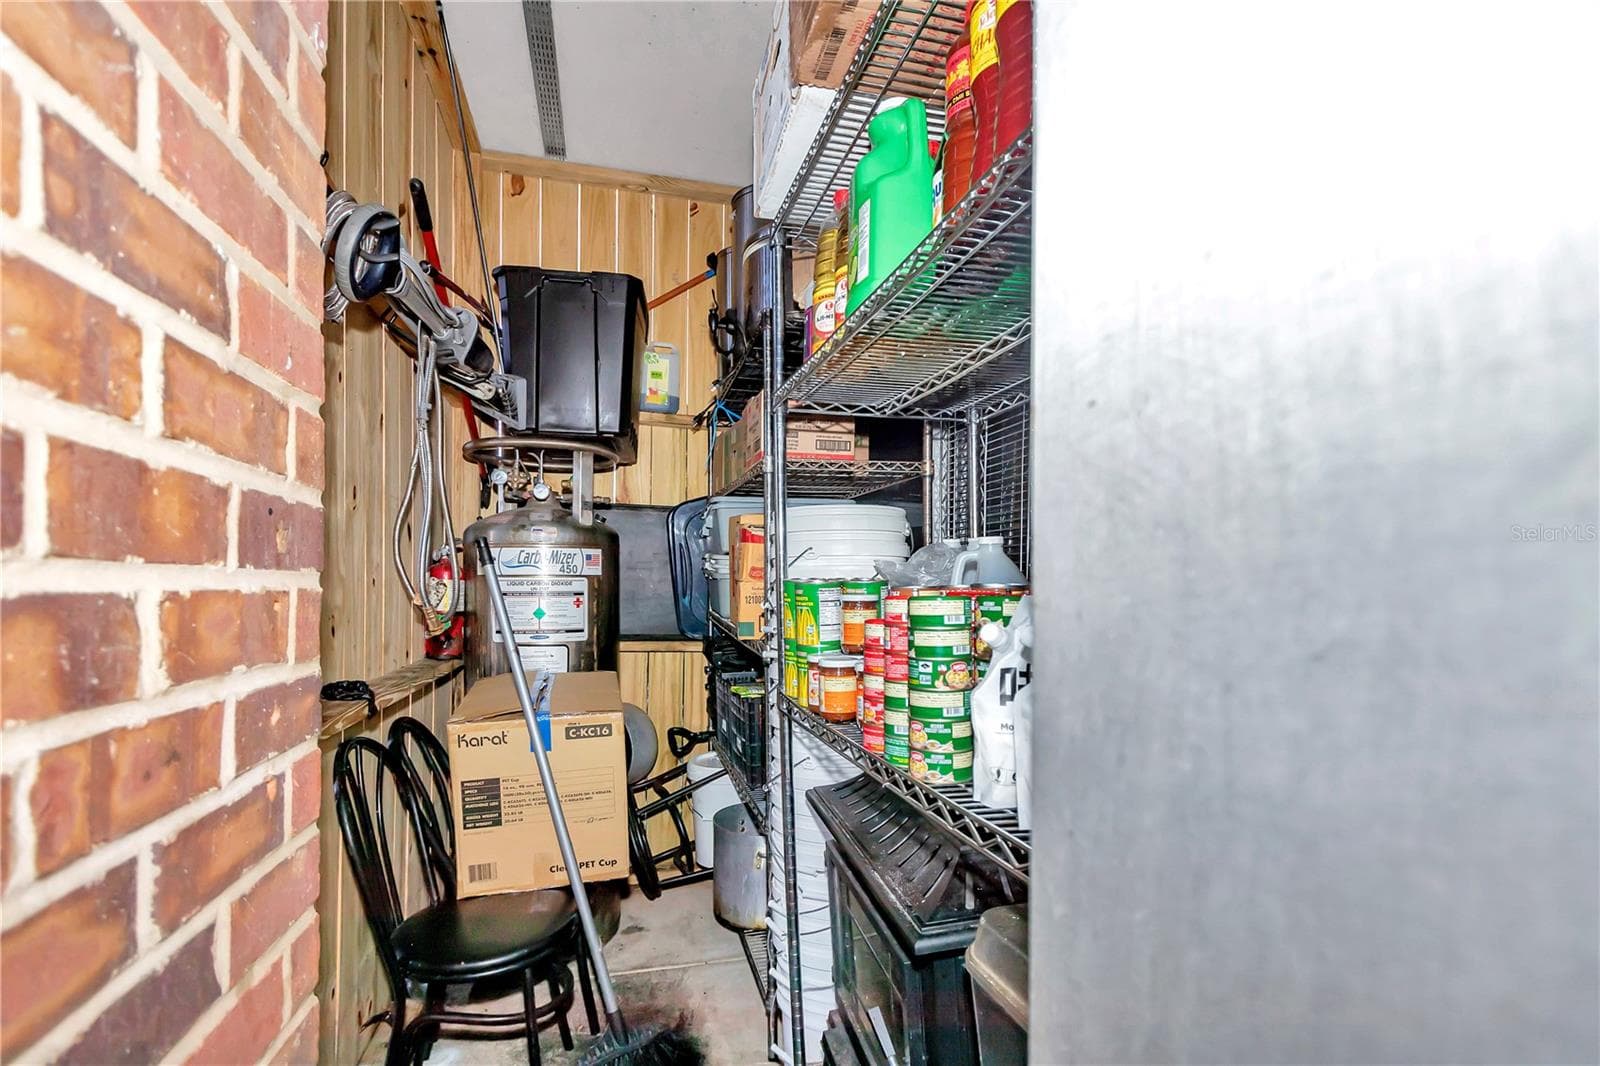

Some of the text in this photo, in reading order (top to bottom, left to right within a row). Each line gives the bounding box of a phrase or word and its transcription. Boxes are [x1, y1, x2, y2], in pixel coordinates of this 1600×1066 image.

[559, 564, 578, 574] 450
[569, 726, 610, 738] C-KC16
[457, 730, 508, 749] Karat
[579, 860, 595, 869] PET
[598, 858, 618, 868] Cup
